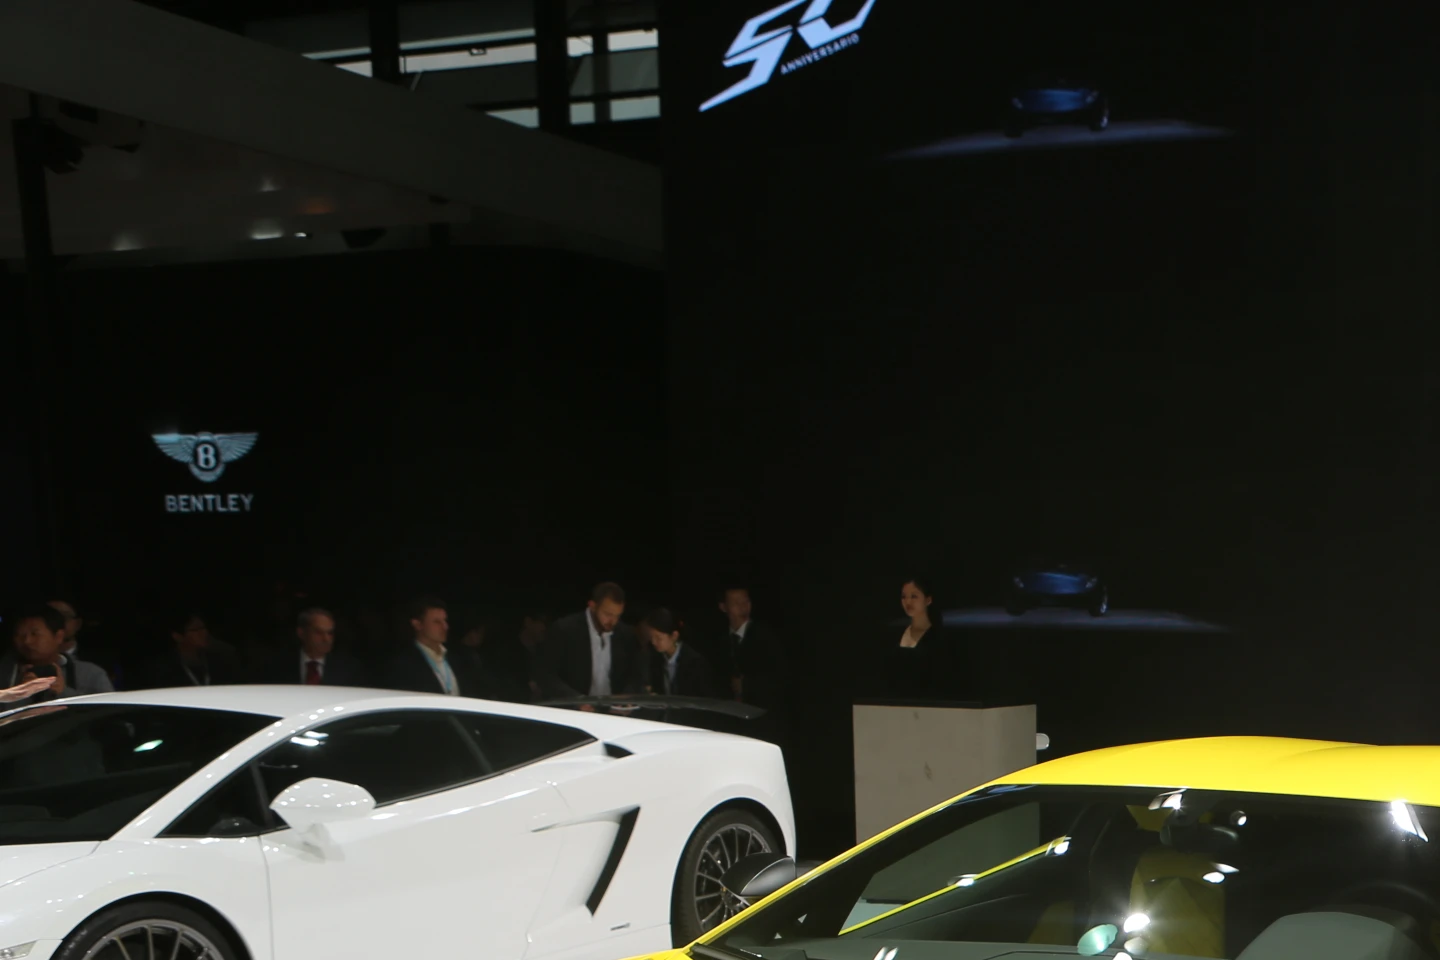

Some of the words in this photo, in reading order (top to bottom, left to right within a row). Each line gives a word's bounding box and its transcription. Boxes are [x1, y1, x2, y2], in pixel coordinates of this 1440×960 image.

[779, 33, 861, 76] ANNIVERSARIO
[196, 443, 217, 470] B
[164, 493, 255, 513] BENTLEY
